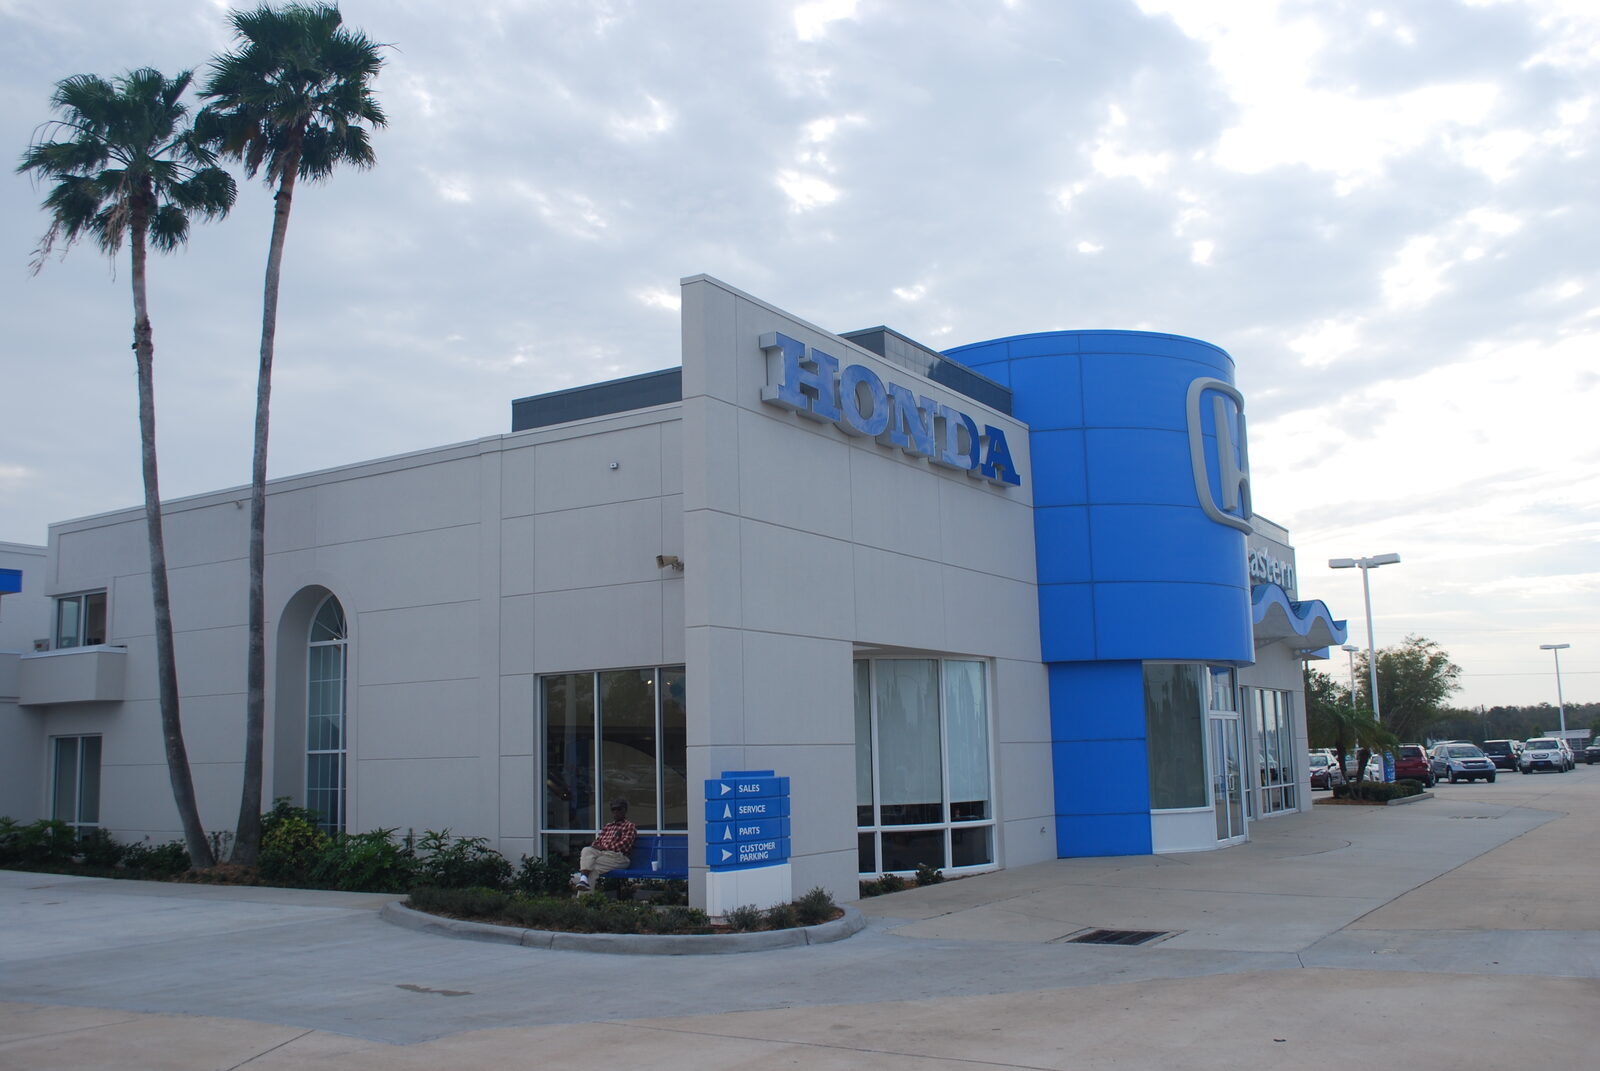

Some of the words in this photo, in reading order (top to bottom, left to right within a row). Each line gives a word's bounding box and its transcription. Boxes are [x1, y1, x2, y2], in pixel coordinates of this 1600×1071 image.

[759, 331, 1021, 486] HONDA
[738, 784, 760, 793] SALES
[738, 804, 766, 814] SERVICE
[739, 826, 760, 836] PARTS
[739, 841, 776, 853] CUSTOMER
[739, 851, 769, 862] PARKING
